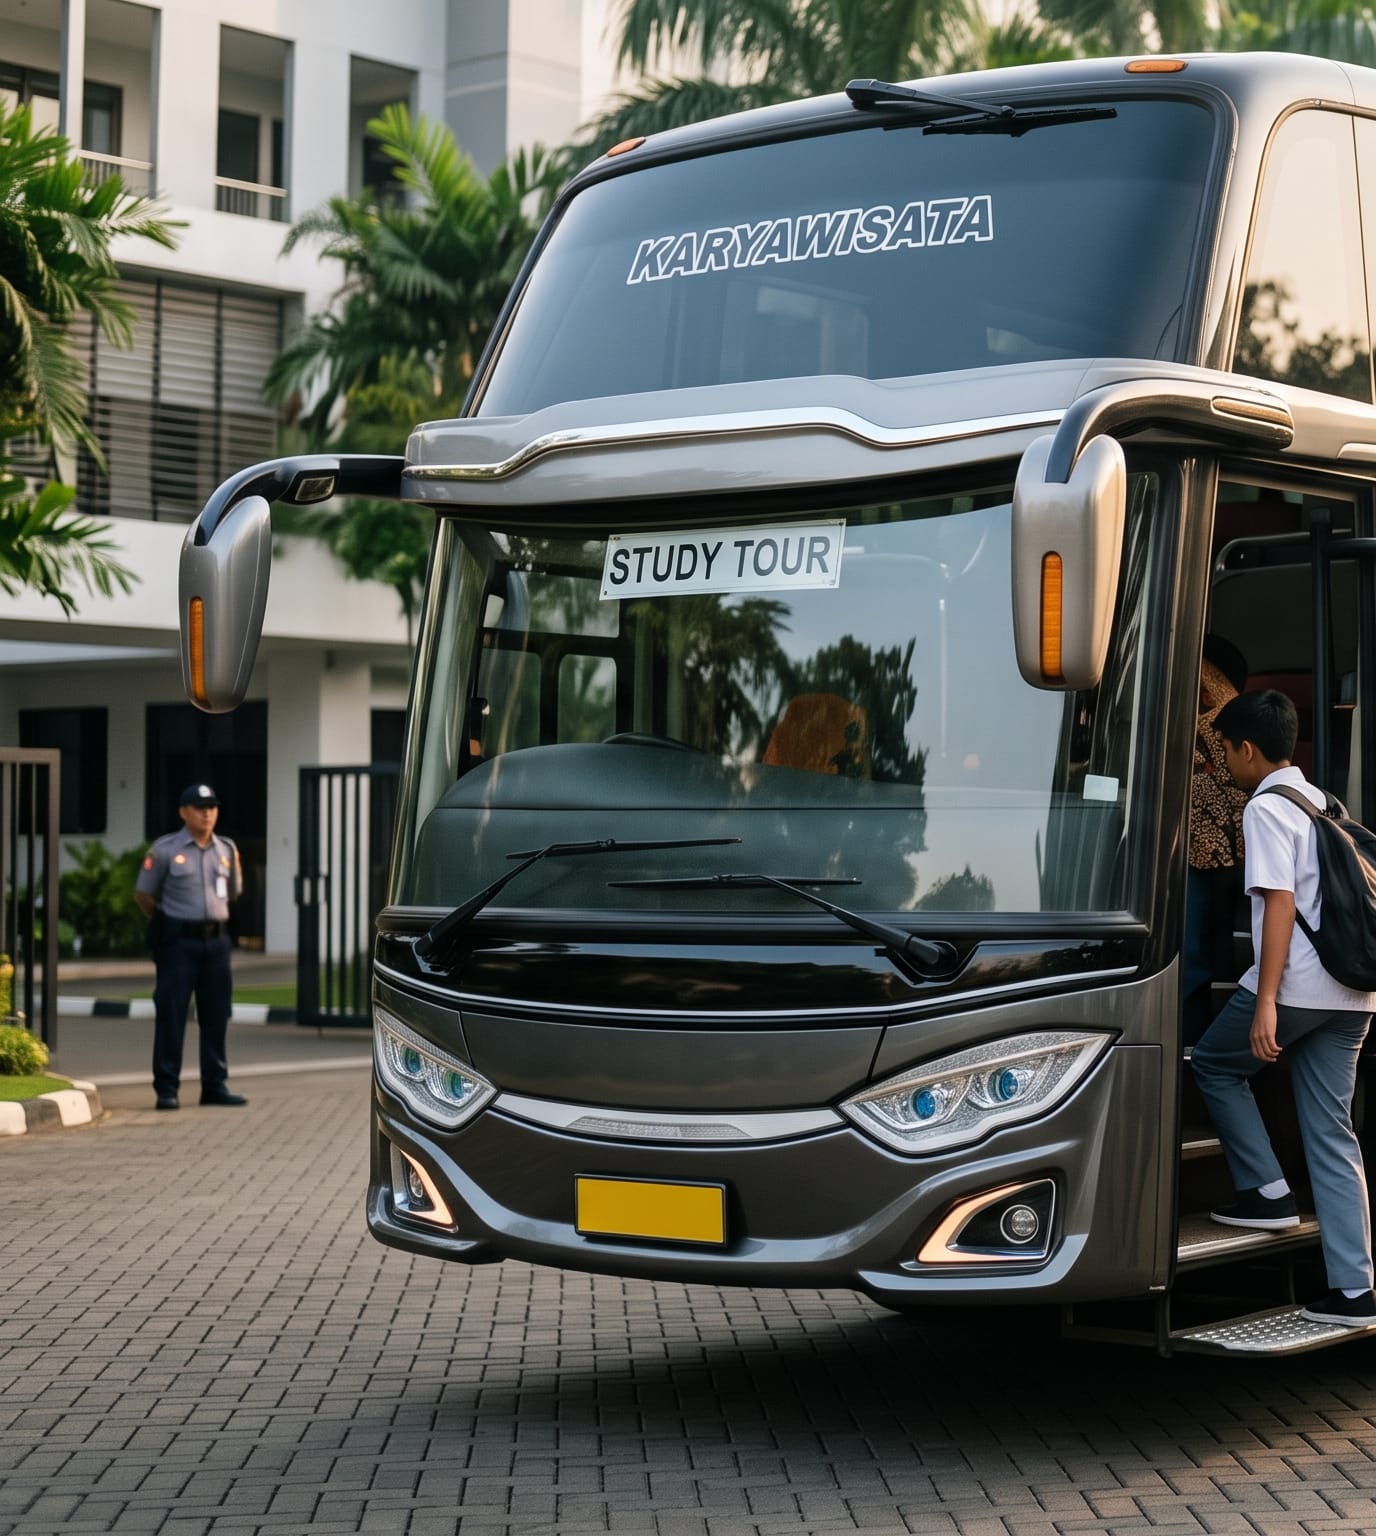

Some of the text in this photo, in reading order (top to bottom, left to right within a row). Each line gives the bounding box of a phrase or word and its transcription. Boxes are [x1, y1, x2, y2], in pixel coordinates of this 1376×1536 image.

[626, 195, 993, 285] KARYAWISATA
[609, 536, 831, 585] STUDY TOUR
